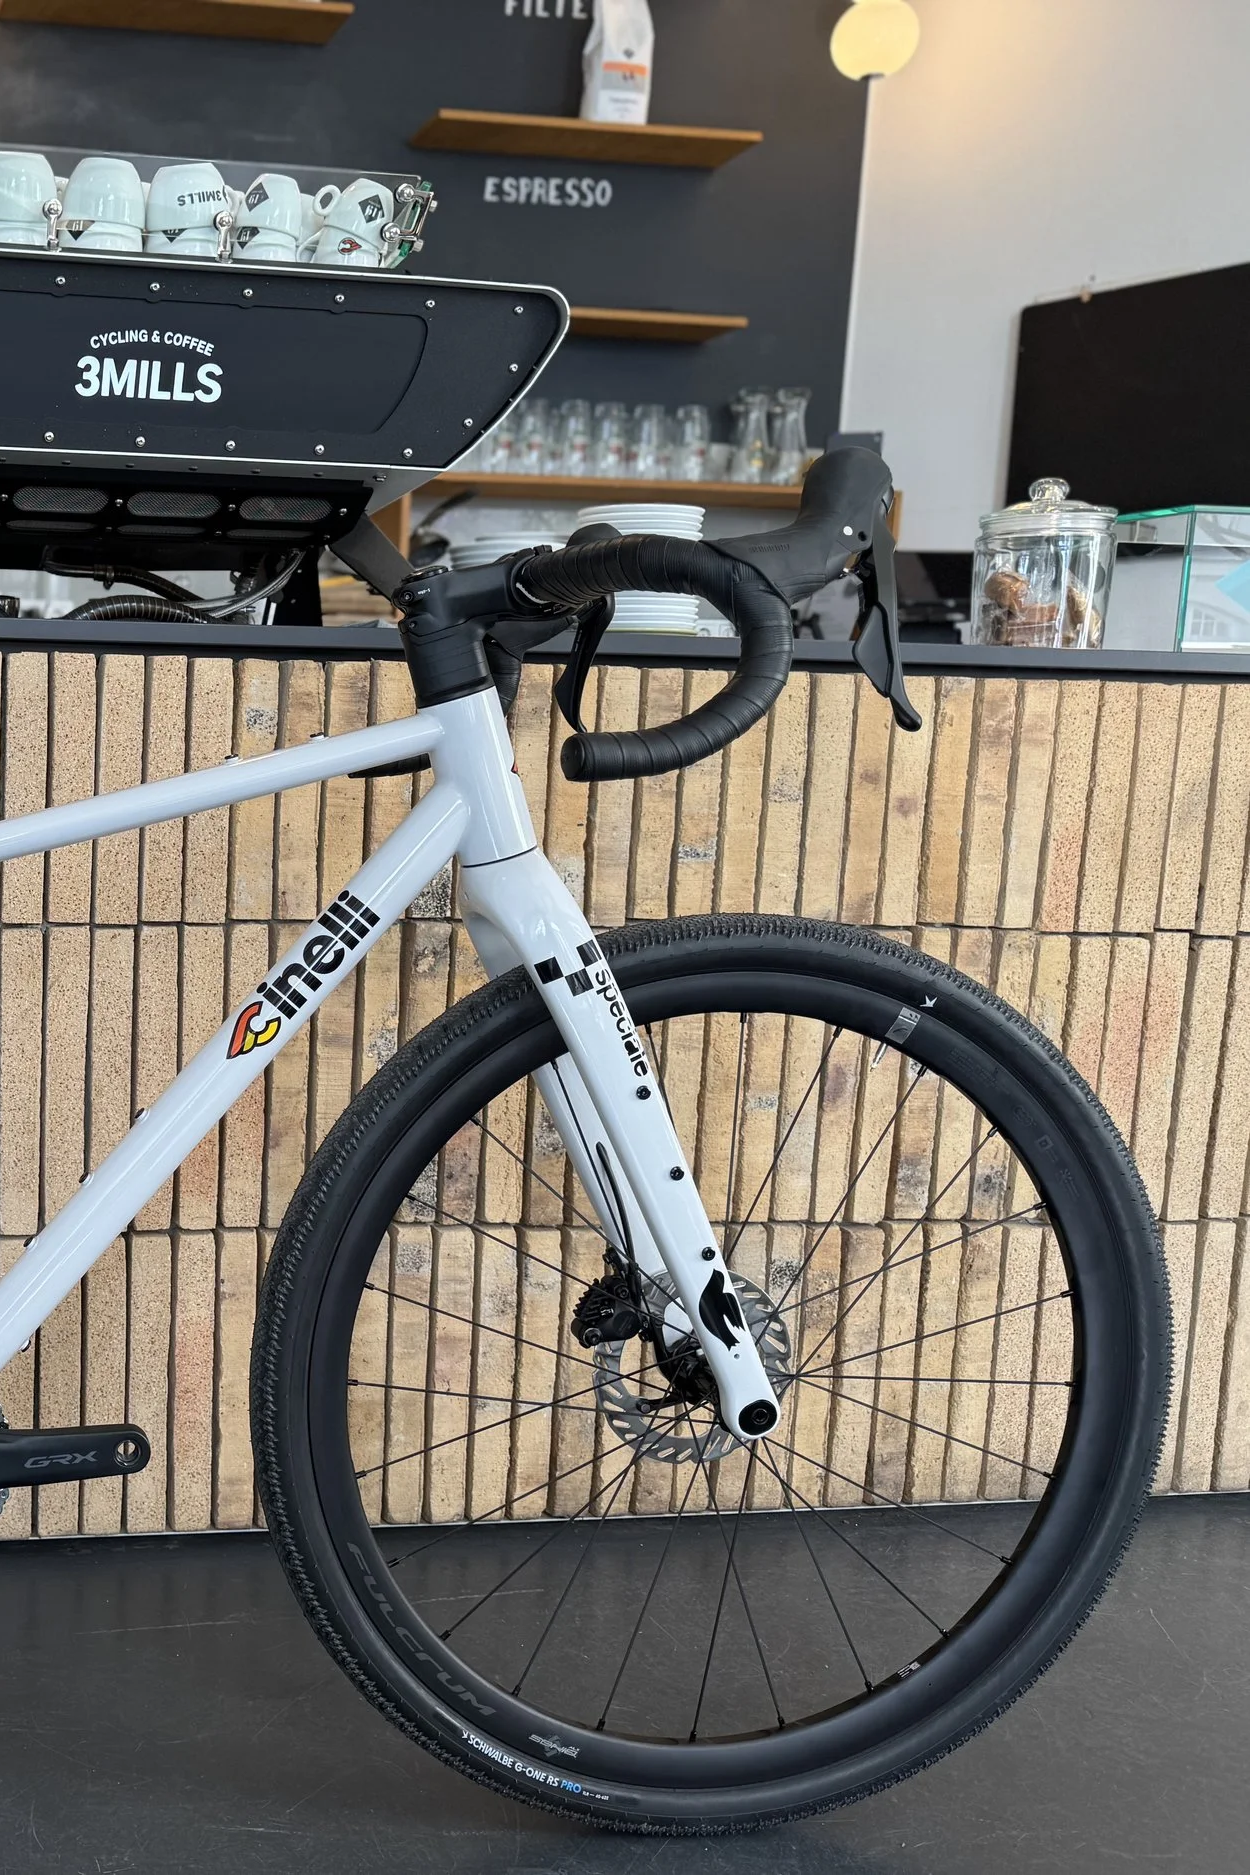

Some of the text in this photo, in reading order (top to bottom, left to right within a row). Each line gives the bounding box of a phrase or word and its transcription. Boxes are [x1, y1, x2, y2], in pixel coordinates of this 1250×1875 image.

[504, 0, 589, 19] FILTE
[483, 176, 613, 208] ESPRESSO
[90, 329, 215, 357] CYCLING & COFFEE
[74, 355, 224, 403] 3MILLS
[24, 1450, 98, 1469] GRX
[468, 1734, 513, 1769] SCHWALBE
[514, 1760, 547, 1782] G-ONE
[546, 1776, 560, 1787] RS
[560, 1779, 582, 1794] PRO
